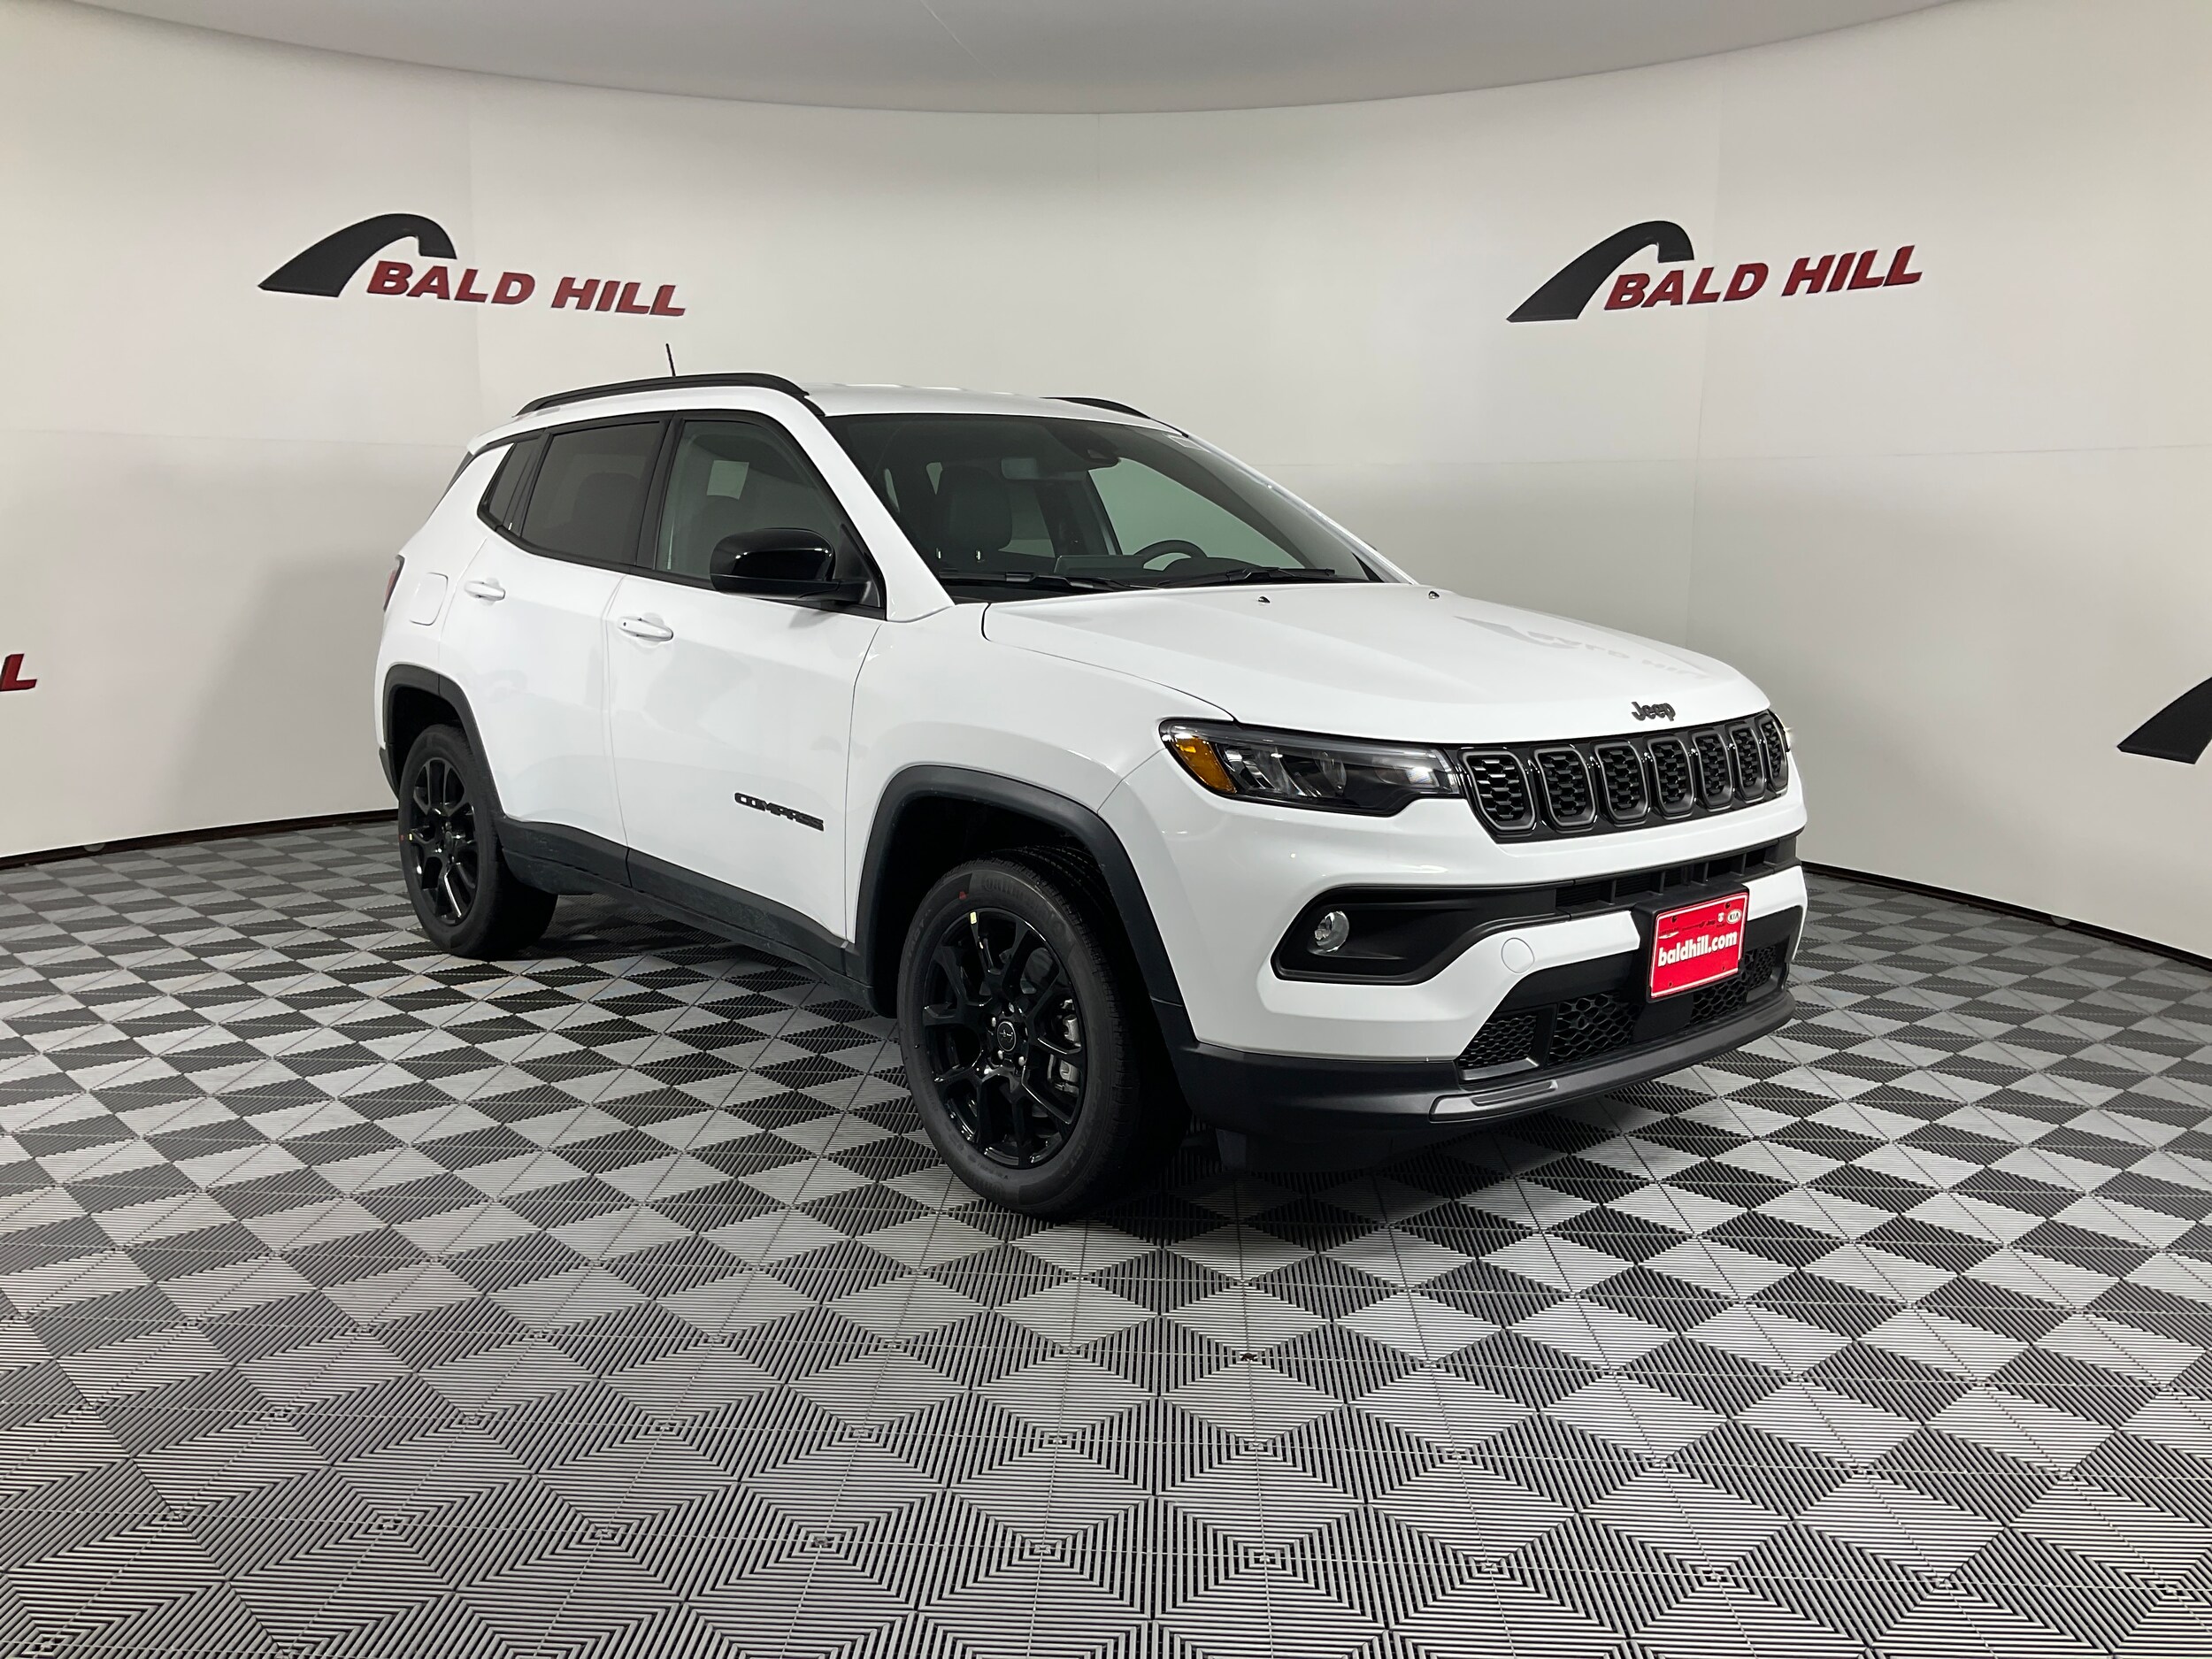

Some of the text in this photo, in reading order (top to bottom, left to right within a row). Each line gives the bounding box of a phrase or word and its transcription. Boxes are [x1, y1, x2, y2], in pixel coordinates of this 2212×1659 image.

[366, 260, 686, 317] BALD HILL
[1603, 245, 1923, 311] BALD HILL
[1631, 701, 1676, 722] Jeep
[733, 792, 825, 832] COMPASS
[1657, 931, 1738, 967] baldhill.com
